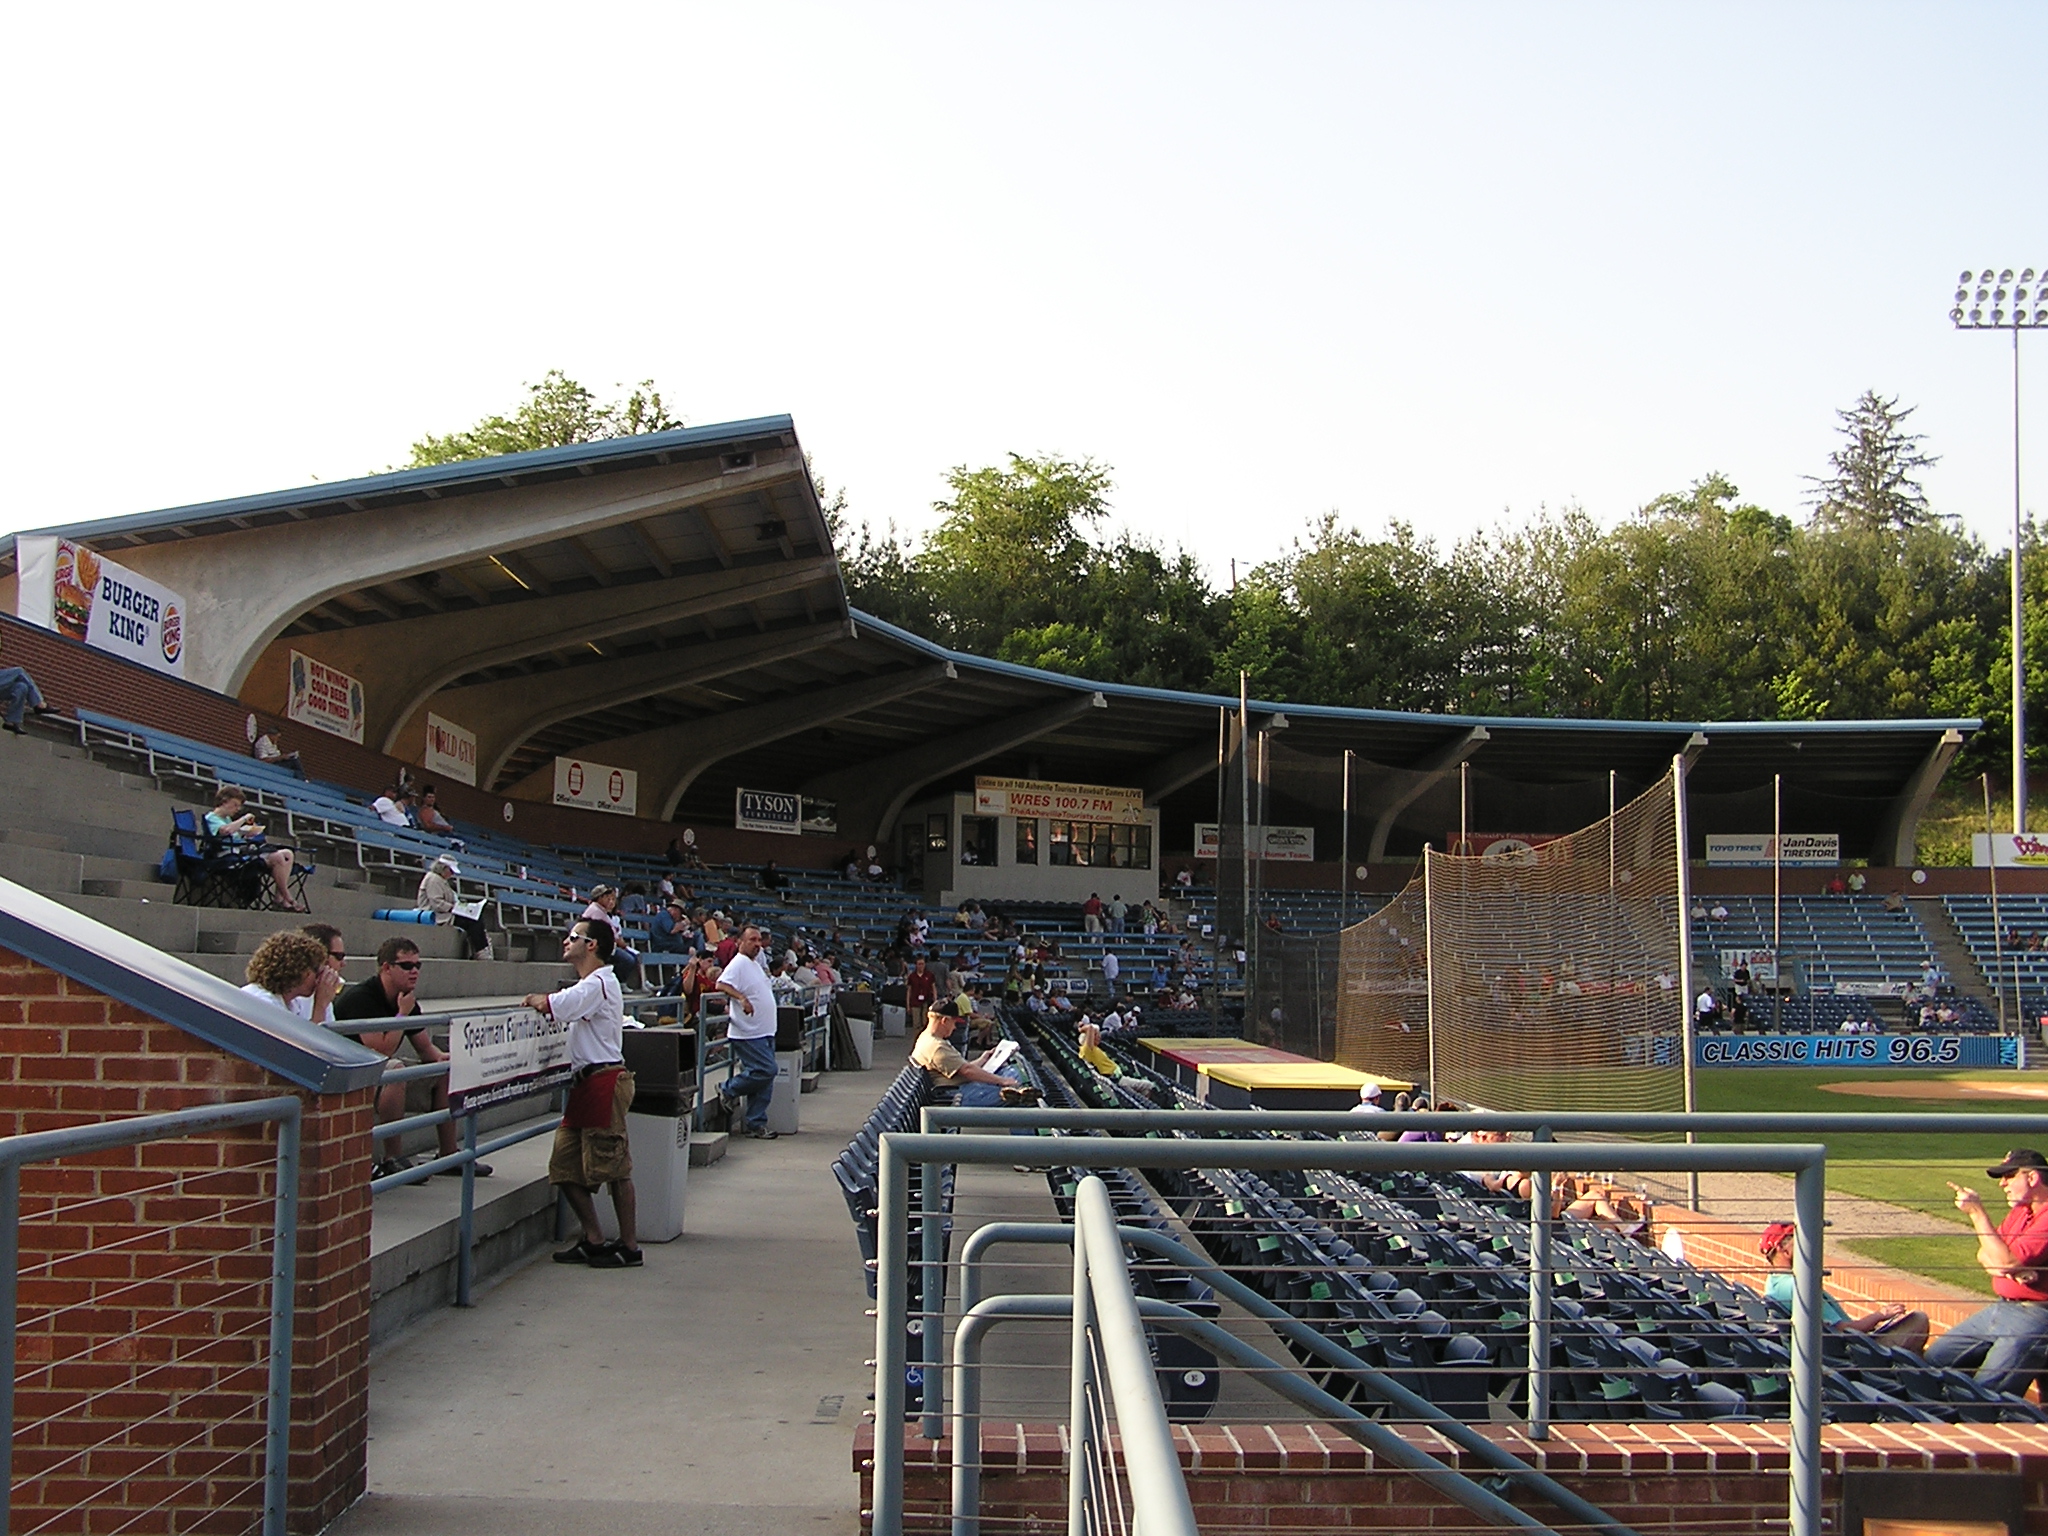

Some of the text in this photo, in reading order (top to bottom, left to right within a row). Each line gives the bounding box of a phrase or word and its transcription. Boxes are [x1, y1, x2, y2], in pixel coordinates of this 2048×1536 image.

[102, 575, 159, 623] BURGER
[109, 610, 145, 647] KING
[310, 662, 349, 690] HOT WINGS
[308, 693, 327, 712] GOOD
[312, 678, 347, 704] COLD BEER
[428, 724, 475, 766] WORLD GYM
[1025, 782, 1053, 792] Asheville
[1054, 784, 1077, 793] Tourists
[1078, 786, 1104, 796] Baseball
[1105, 788, 1124, 797] Games
[744, 793, 794, 814] TYSON
[1009, 806, 1113, 821] TheAshevilleTourists.com
[1010, 792, 1050, 807] WRES
[1055, 796, 1089, 810] 100.7
[1092, 800, 1113, 812] FM
[744, 810, 793, 821] FURNITURE
[1264, 849, 1287, 858] Home
[1702, 1037, 1961, 1063] CLASSIC HITS 96.5
[2000, 1036, 2017, 1065] ZONE
